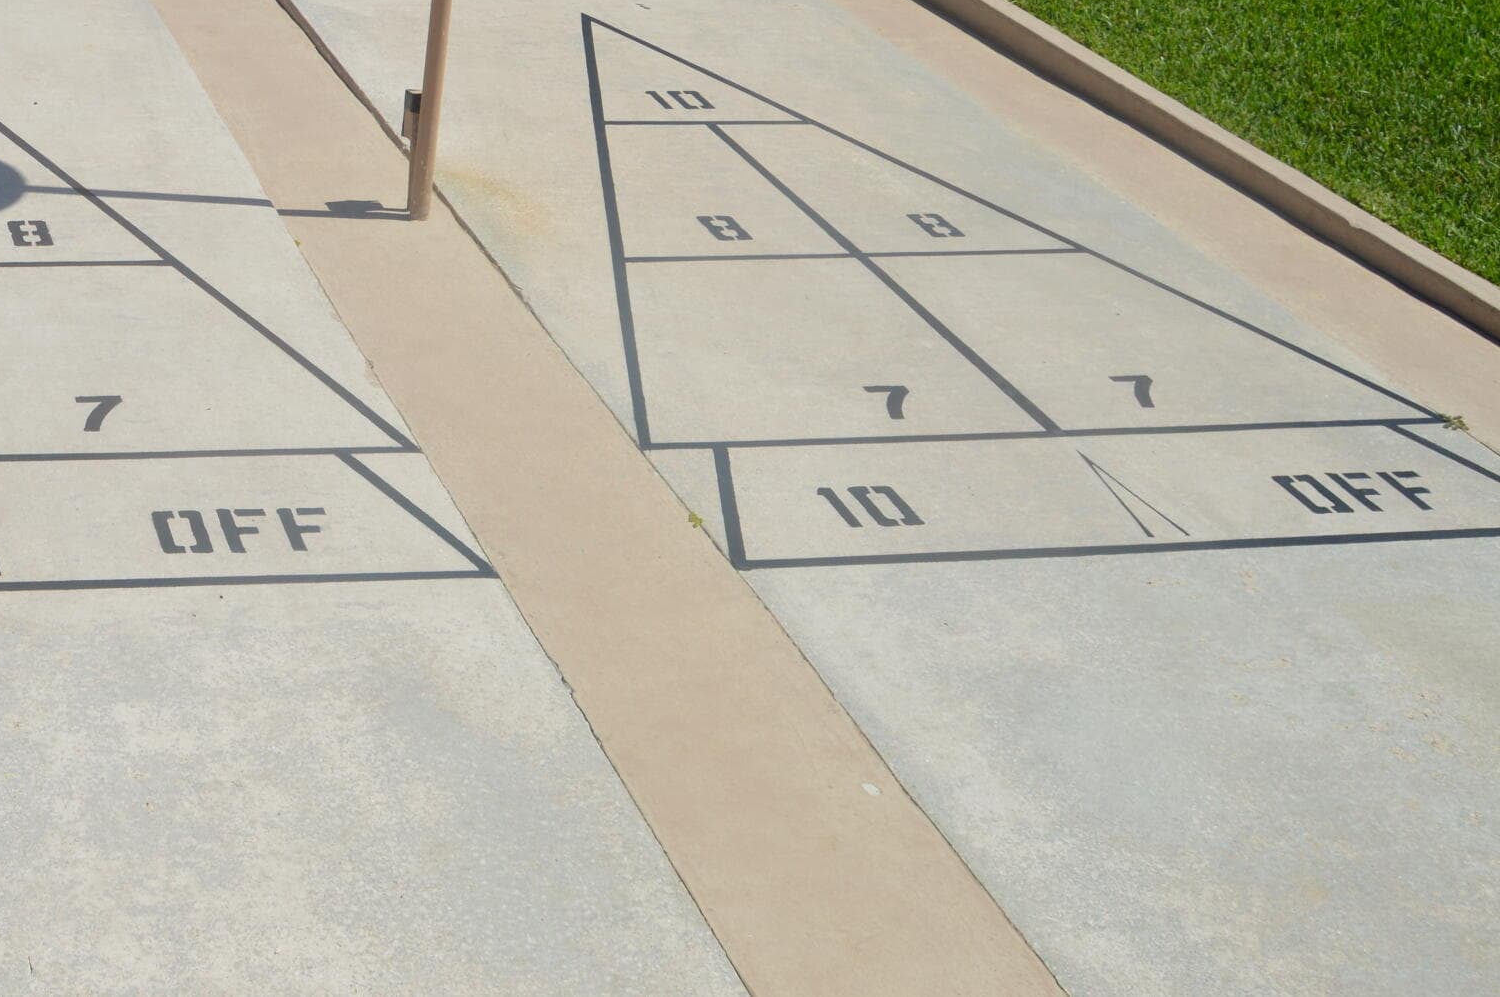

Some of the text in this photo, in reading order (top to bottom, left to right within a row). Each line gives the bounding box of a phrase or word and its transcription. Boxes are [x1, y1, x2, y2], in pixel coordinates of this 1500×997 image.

[644, 90, 716, 110] 10
[6, 220, 55, 247] 8
[695, 213, 966, 242] 8 8
[74, 394, 123, 433] 7
[862, 374, 1155, 420] 7 7
[816, 470, 1433, 528] 10 OFF
[150, 507, 327, 555] OFF
